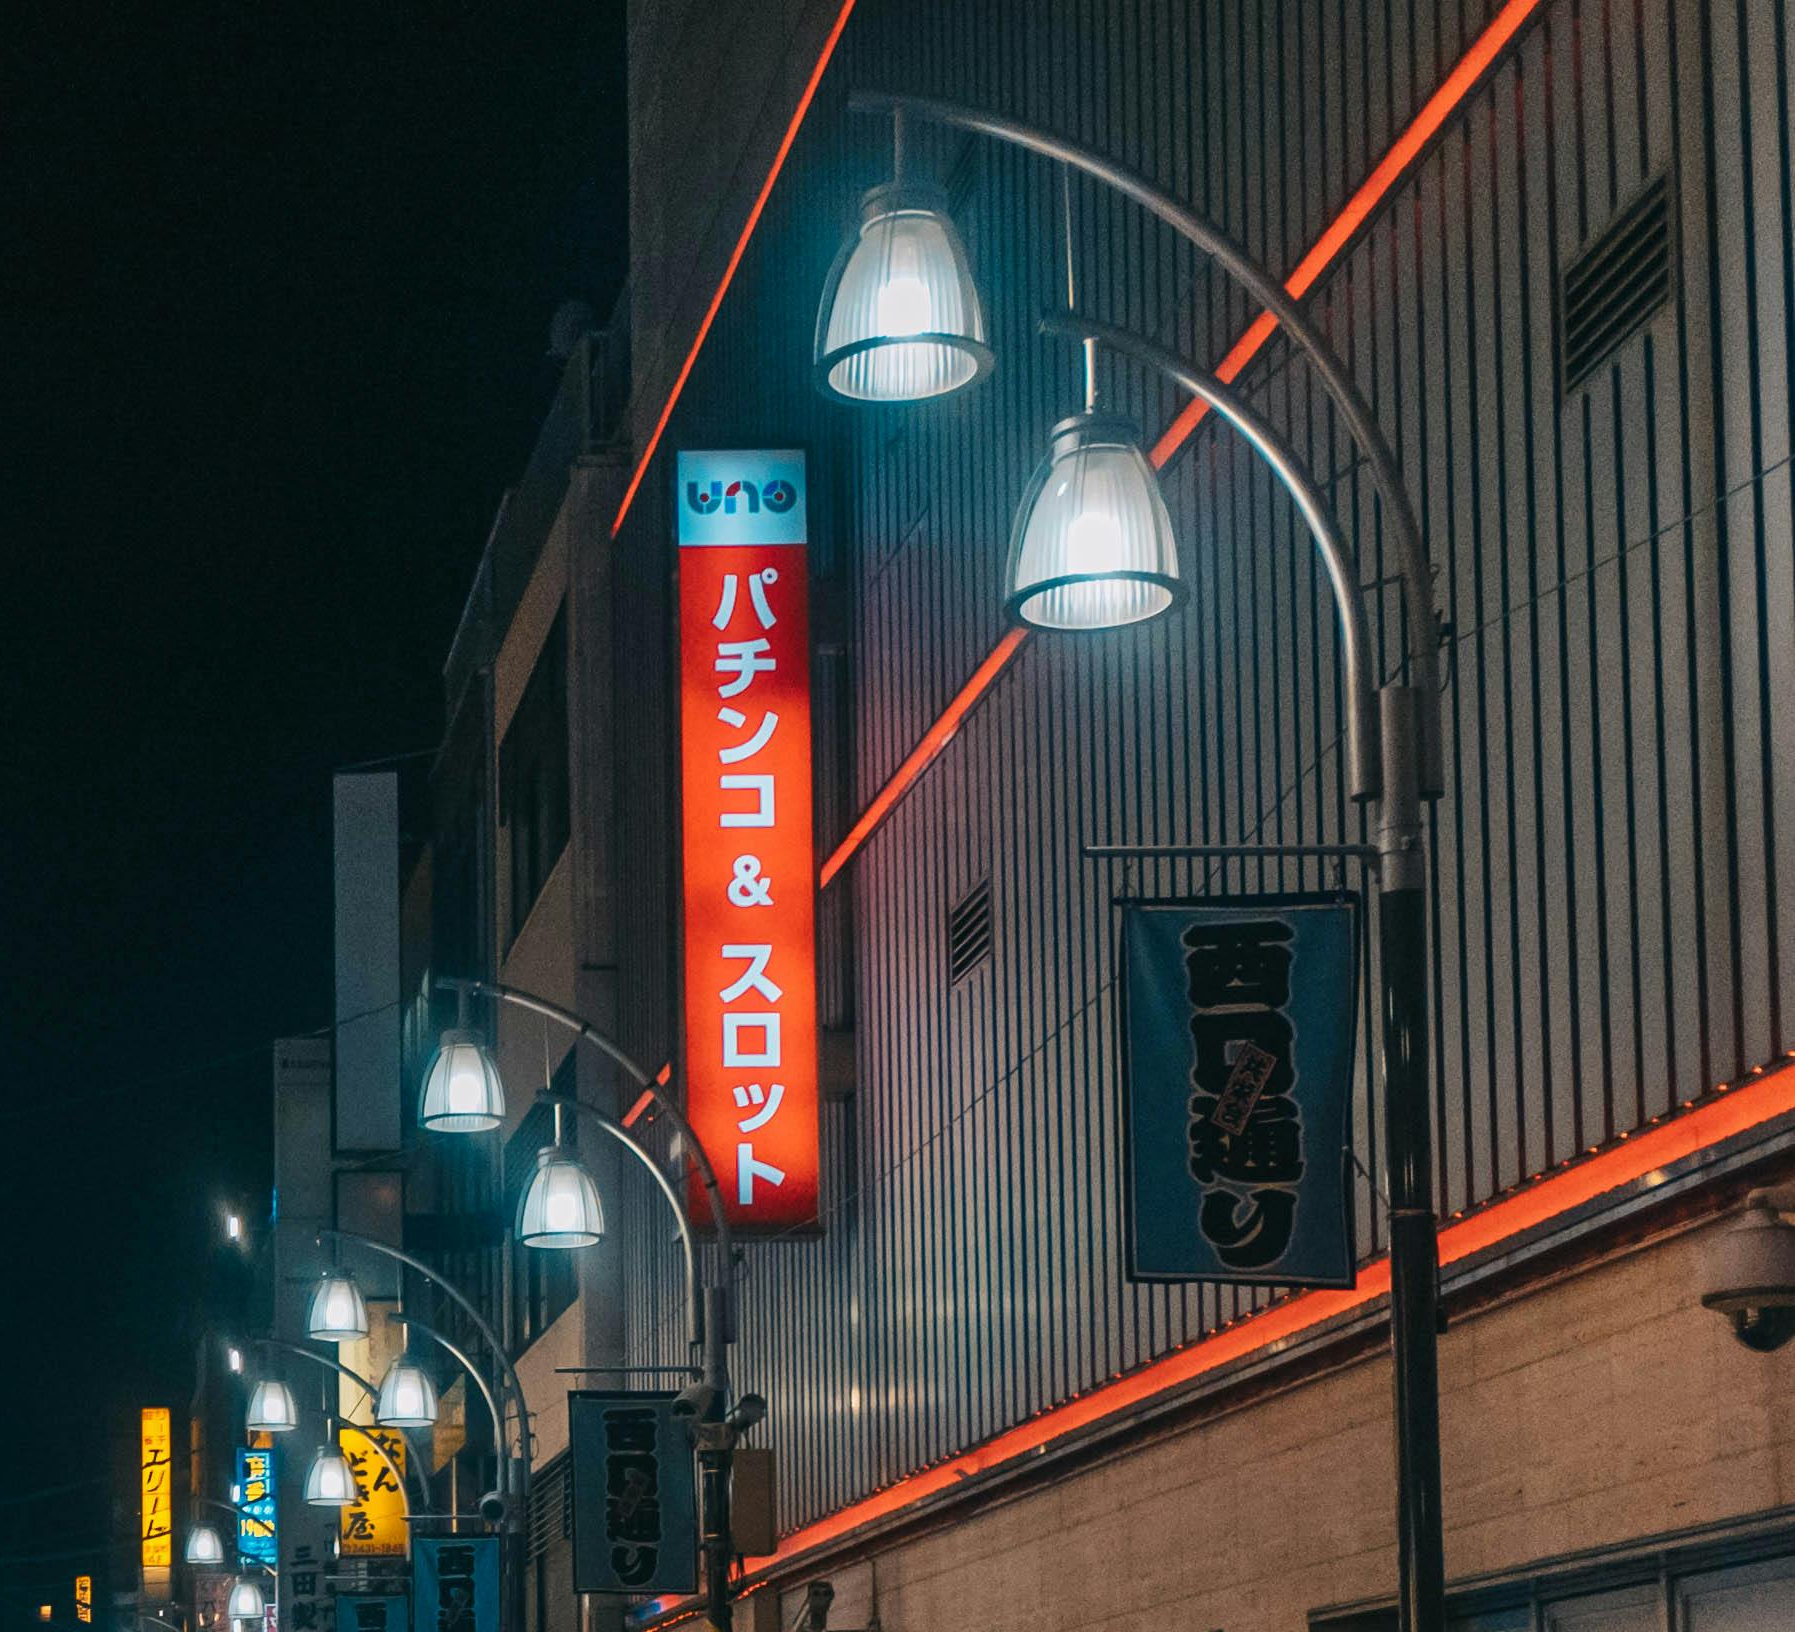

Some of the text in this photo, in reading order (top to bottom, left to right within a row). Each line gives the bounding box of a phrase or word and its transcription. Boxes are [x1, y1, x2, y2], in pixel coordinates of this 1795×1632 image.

[686, 480, 798, 515] uno
[143, 1447, 172, 1540] エリート
